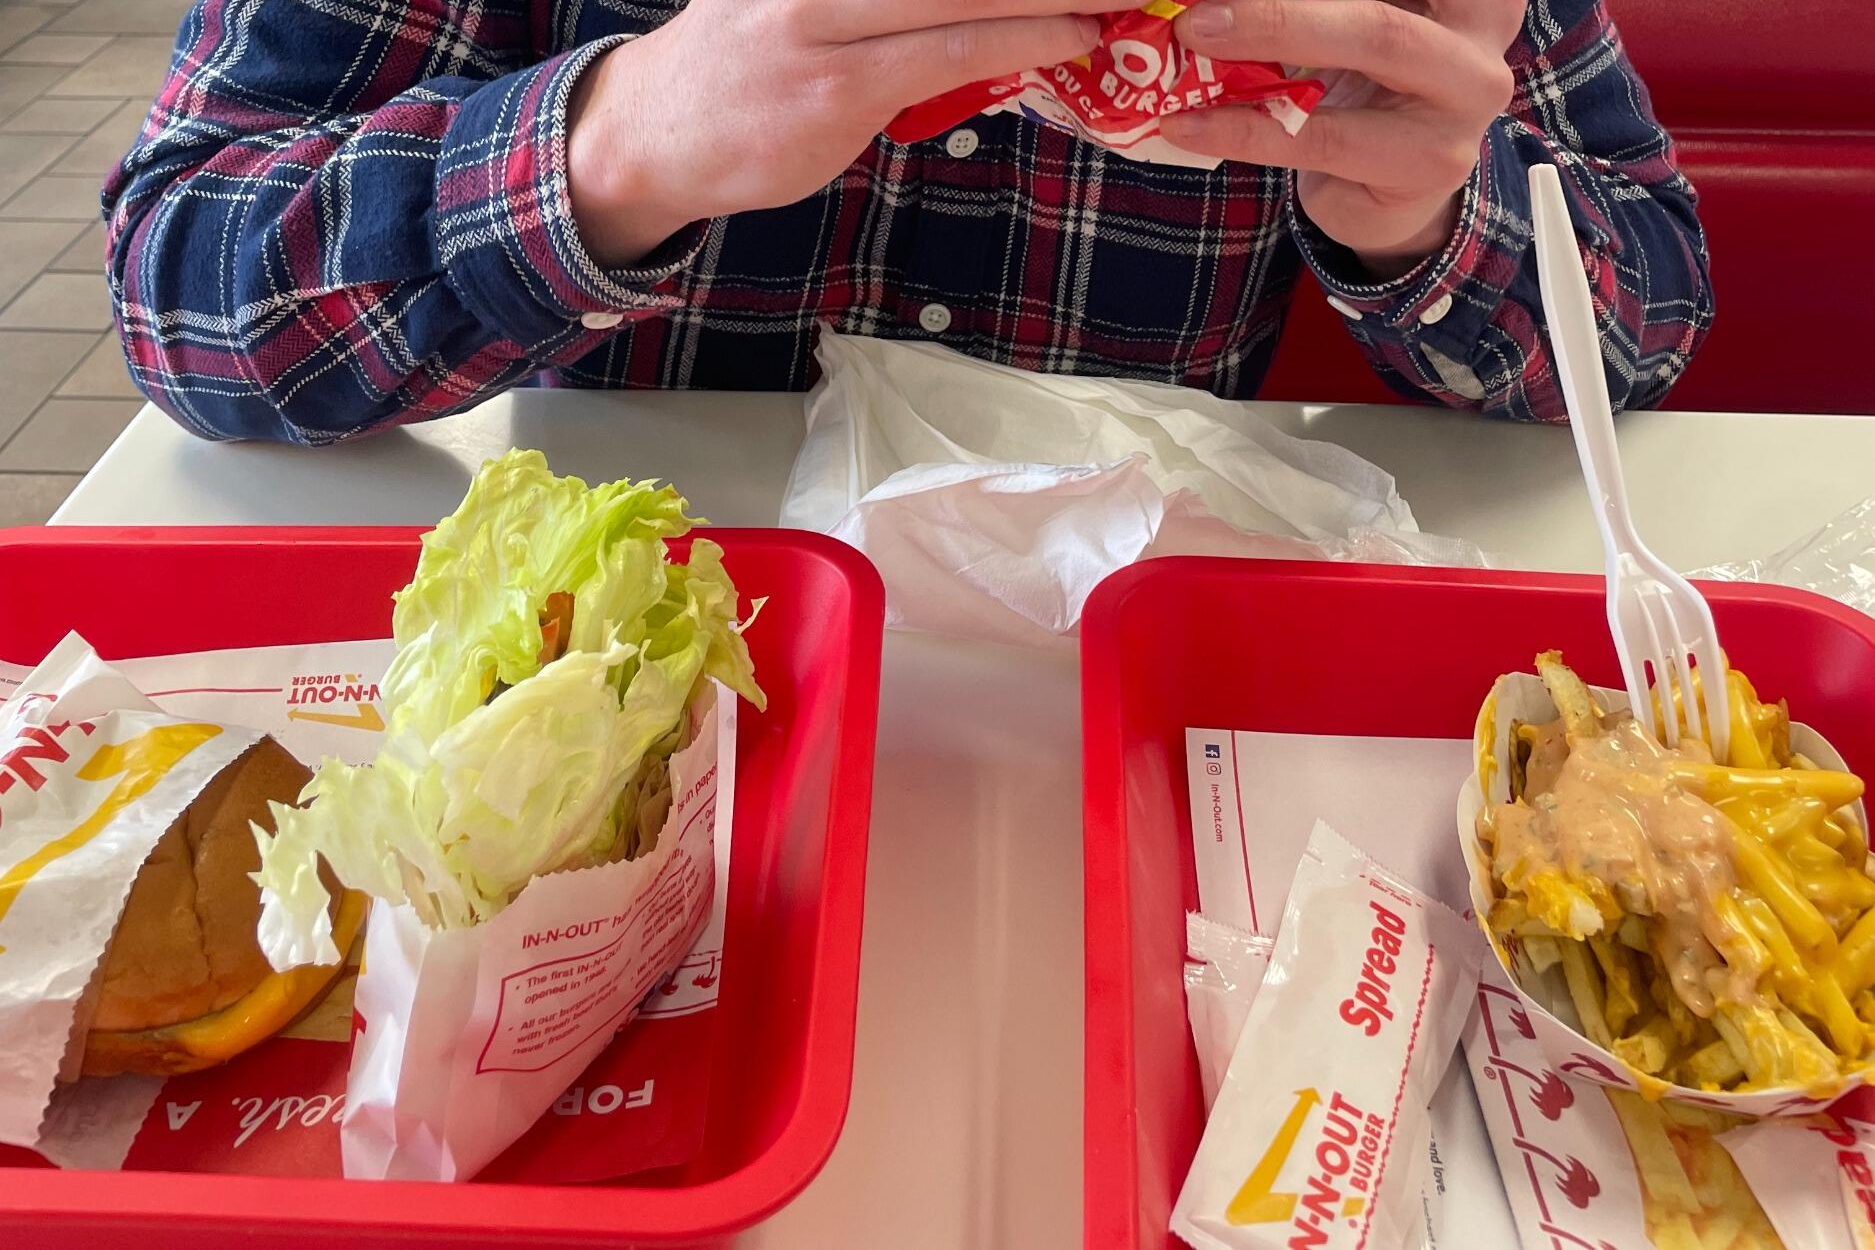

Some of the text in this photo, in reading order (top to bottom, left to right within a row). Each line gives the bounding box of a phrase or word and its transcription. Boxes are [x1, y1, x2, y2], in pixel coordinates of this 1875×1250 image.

[291, 674, 341, 686] BURGER
[286, 684, 383, 704] N-N-OUT
[1210, 783, 1223, 843] In-N-Out.com
[526, 975, 547, 989] The
[551, 967, 574, 980] first
[1339, 900, 1406, 1037] Spread
[524, 981, 568, 1005] opened
[570, 980, 580, 990] in
[521, 1018, 536, 1030] All
[538, 1011, 558, 1025] our
[517, 1030, 541, 1043] with
[553, 1079, 655, 1117] FOR
[166, 1100, 203, 1131] A
[1349, 1112, 1386, 1193] BURGER
[1429, 1141, 1444, 1165] and
[1287, 1090, 1364, 1250] N-N-OUT
